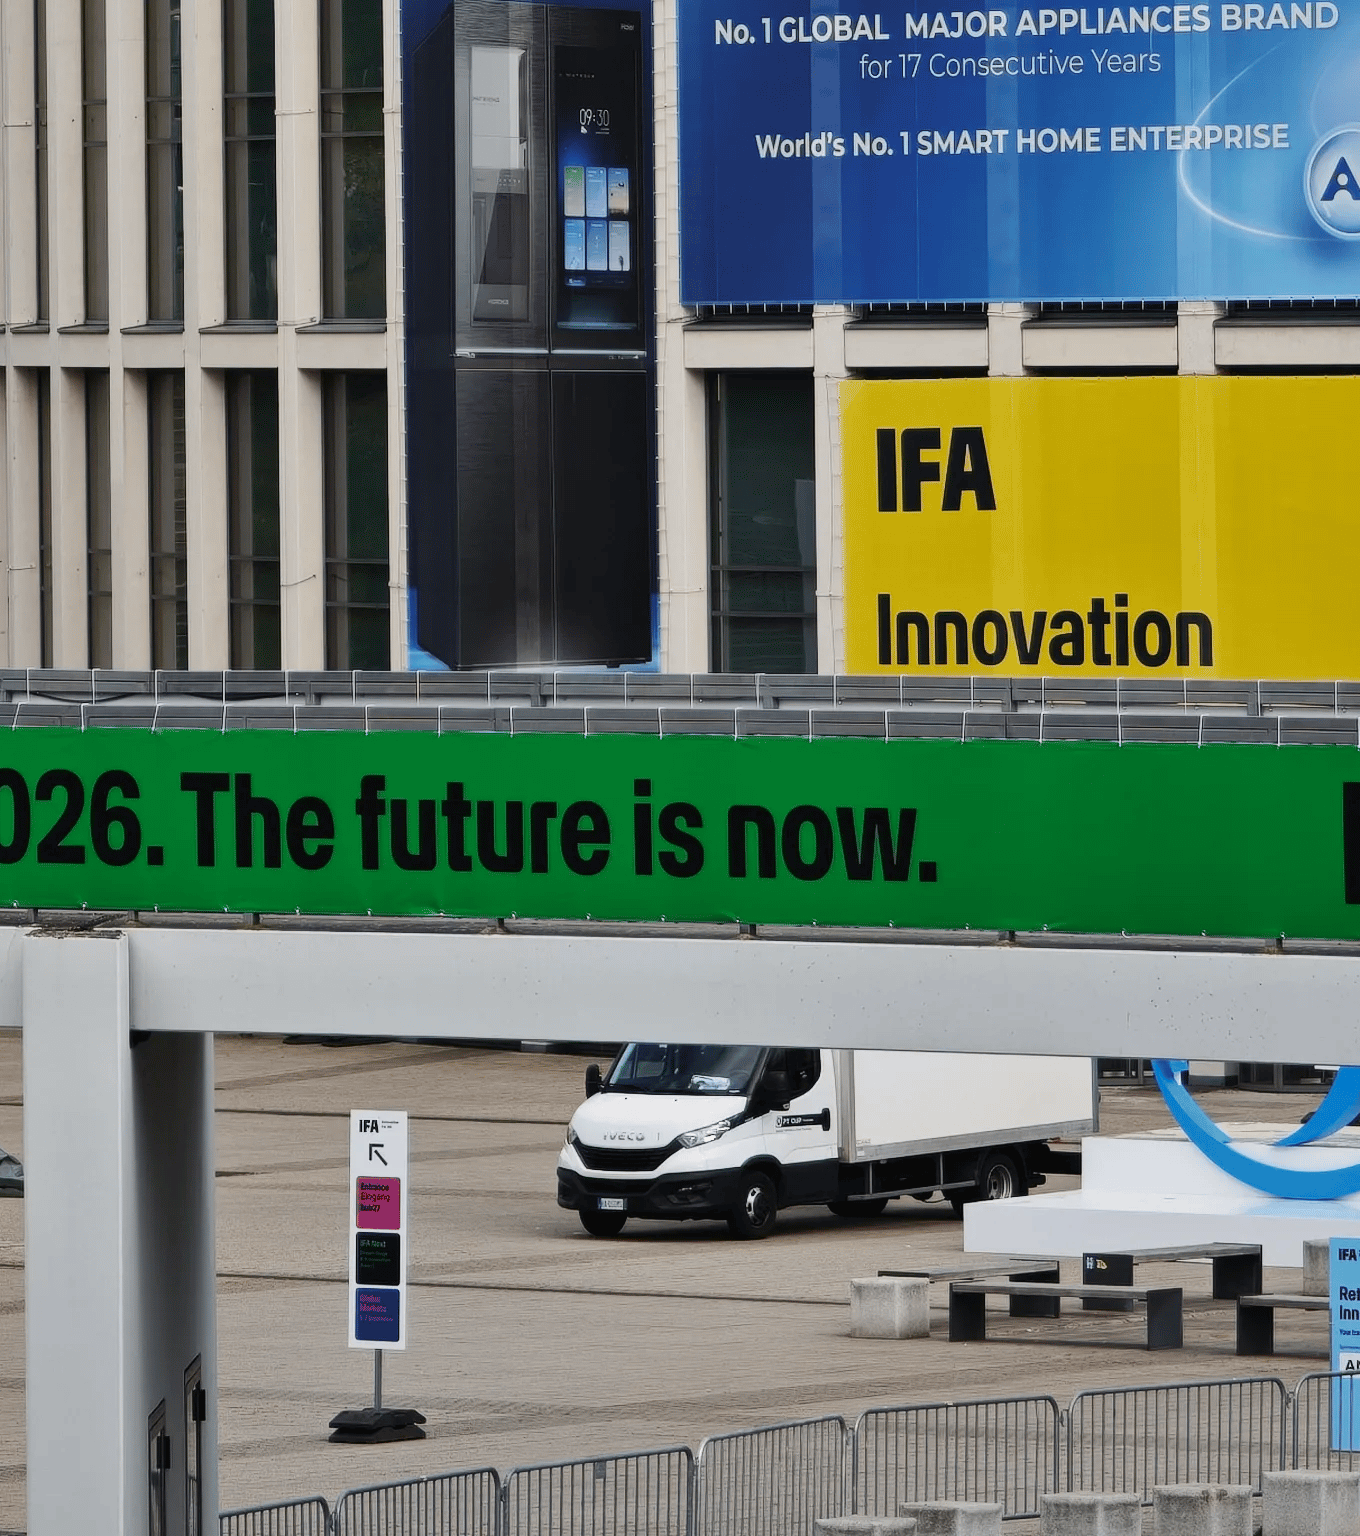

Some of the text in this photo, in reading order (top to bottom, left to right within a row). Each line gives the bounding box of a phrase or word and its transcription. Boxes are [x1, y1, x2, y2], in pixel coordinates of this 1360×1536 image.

[714, 1, 1339, 44] No. 1 GLOBAL MAJOR APPLIANCES BRAND
[860, 49, 1162, 79] for 17 Consecutive Years
[579, 108, 610, 127] 09:30
[755, 124, 1290, 159] World's No. 1 SMART HOME ENTERPRISE
[876, 426, 997, 513] IFA
[878, 593, 1213, 668] Innovation
[181, 772, 336, 870] The
[354, 775, 612, 876] future
[634, 779, 705, 879] is
[728, 804, 938, 883] now.
[359, 1119, 380, 1133] IFA
[603, 1131, 646, 1142] IVECO
[1339, 1248, 1358, 1261] IFA
